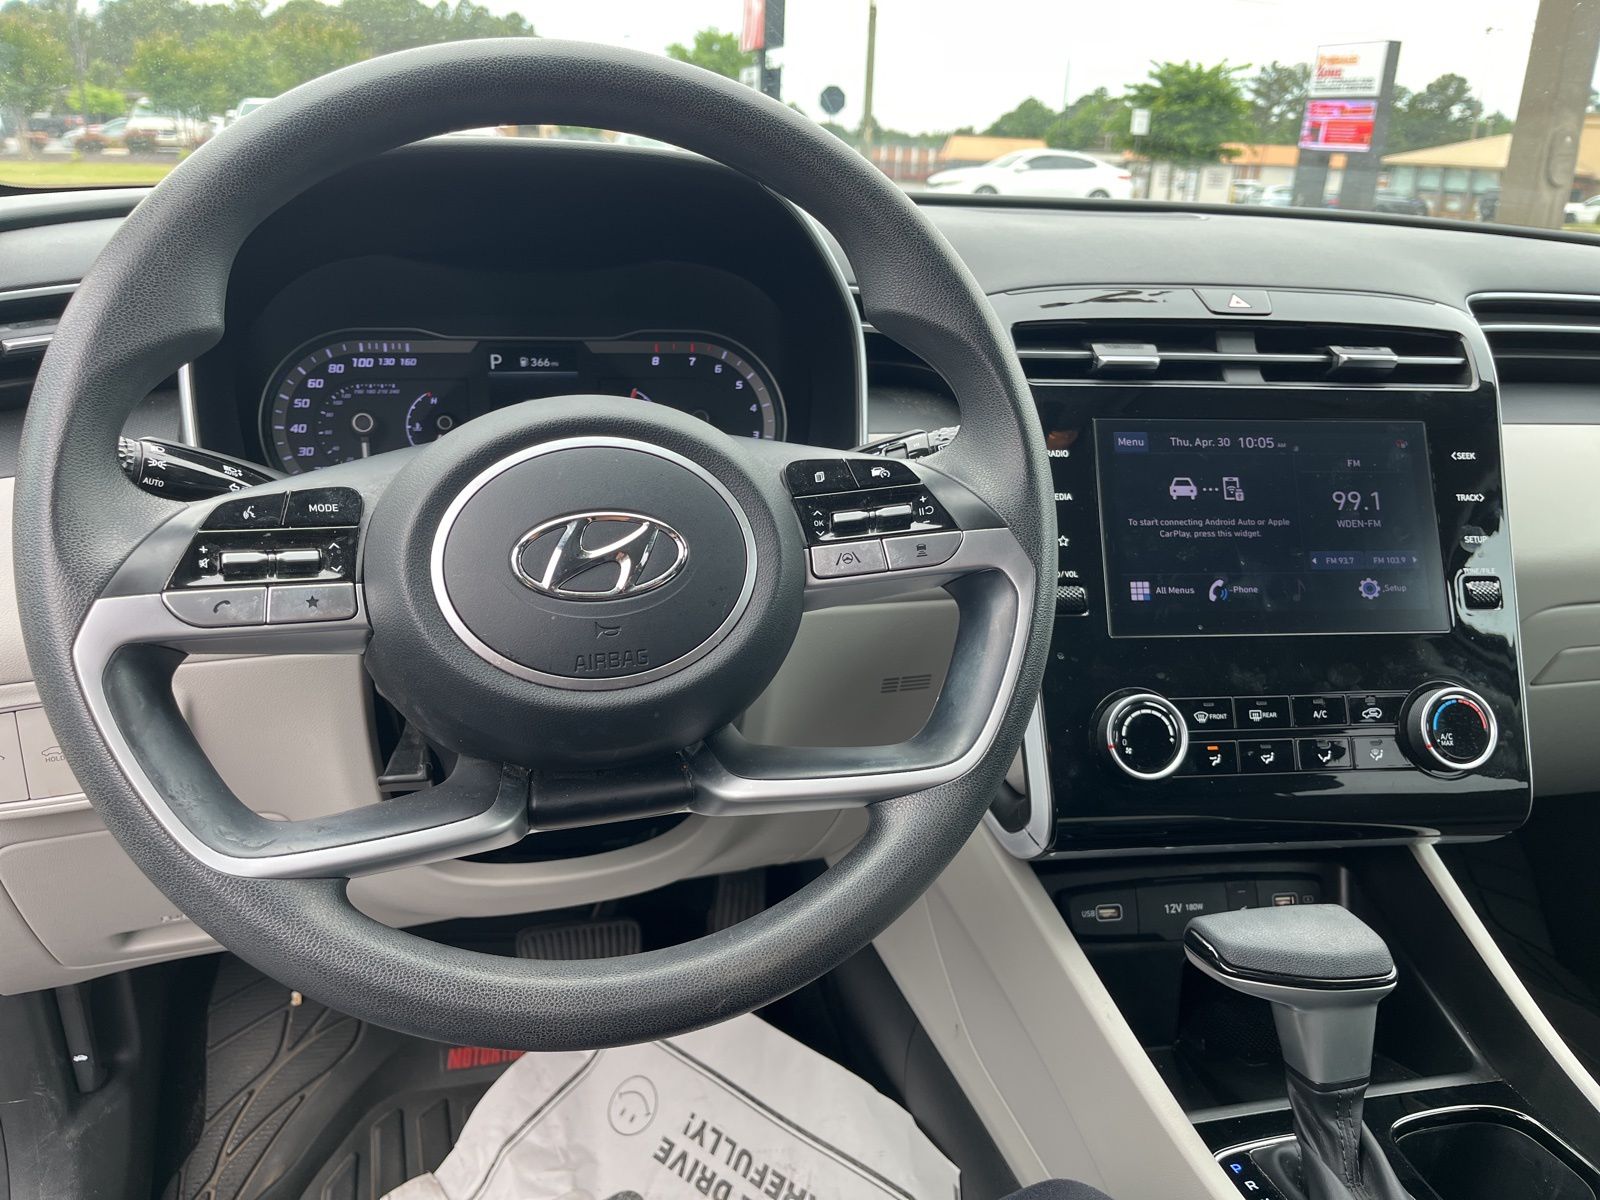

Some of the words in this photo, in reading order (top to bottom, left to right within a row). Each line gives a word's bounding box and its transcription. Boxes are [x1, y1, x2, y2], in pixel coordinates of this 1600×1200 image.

[352, 357, 374, 368] 100
[378, 357, 396, 366] 130
[400, 357, 417, 366] 160
[490, 353, 503, 370] P
[530, 357, 550, 367] 366
[651, 356, 660, 366] 8
[688, 357, 696, 366] 7
[327, 363, 345, 374] 80
[714, 364, 722, 373] 6
[307, 378, 325, 389] 60
[735, 380, 743, 390] 5
[293, 398, 311, 409] 50
[750, 404, 757, 412] 4
[290, 423, 308, 434] 40
[752, 431, 760, 439] 3
[1117, 437, 1144, 446] Menu
[1195, 437, 1216, 449] Apr.
[1217, 437, 1231, 447] 30
[1238, 437, 1275, 448] 10:05
[297, 446, 315, 457] 30
[1456, 452, 1477, 460] SEEK
[1347, 459, 1361, 467] FM
[142, 476, 165, 488] AUTO
[1054, 492, 1073, 501] EDIA
[1332, 491, 1380, 511] 99.1
[1456, 493, 1479, 502] TRACK
[308, 503, 339, 512] MODE
[813, 519, 825, 527] OK
[1128, 518, 1138, 526] To
[1139, 518, 1159, 526] start
[1160, 518, 1203, 527] connecting
[1204, 518, 1236, 526] Android
[1237, 518, 1255, 526] Auto
[1267, 518, 1291, 527] Apple
[1337, 519, 1382, 528] WDEN-FM
[1159, 530, 1192, 539] CarPlay,
[1193, 530, 1216, 539] press
[1217, 529, 1233, 538] this
[1234, 529, 1261, 539] widget.
[1463, 535, 1488, 544] SETUP
[1373, 556, 1385, 564] FM
[1386, 556, 1406, 564] 103.9
[1155, 585, 1167, 594] All
[1167, 585, 1195, 594] Menus
[1384, 583, 1408, 593] Setup
[574, 648, 649, 674] AIRBAG
[1313, 710, 1328, 719] A/C
[1440, 732, 1454, 741] A/C
[45, 754, 66, 763] HOLD
[1164, 902, 1183, 915] 12V
[1186, 902, 1204, 912] 180W
[1081, 909, 1096, 919] USB
[683, 1112, 816, 1200] REFULLY!
[652, 1136, 733, 1200] DRIVE
[1229, 1162, 1243, 1175] P
[1243, 1179, 1260, 1191] R
